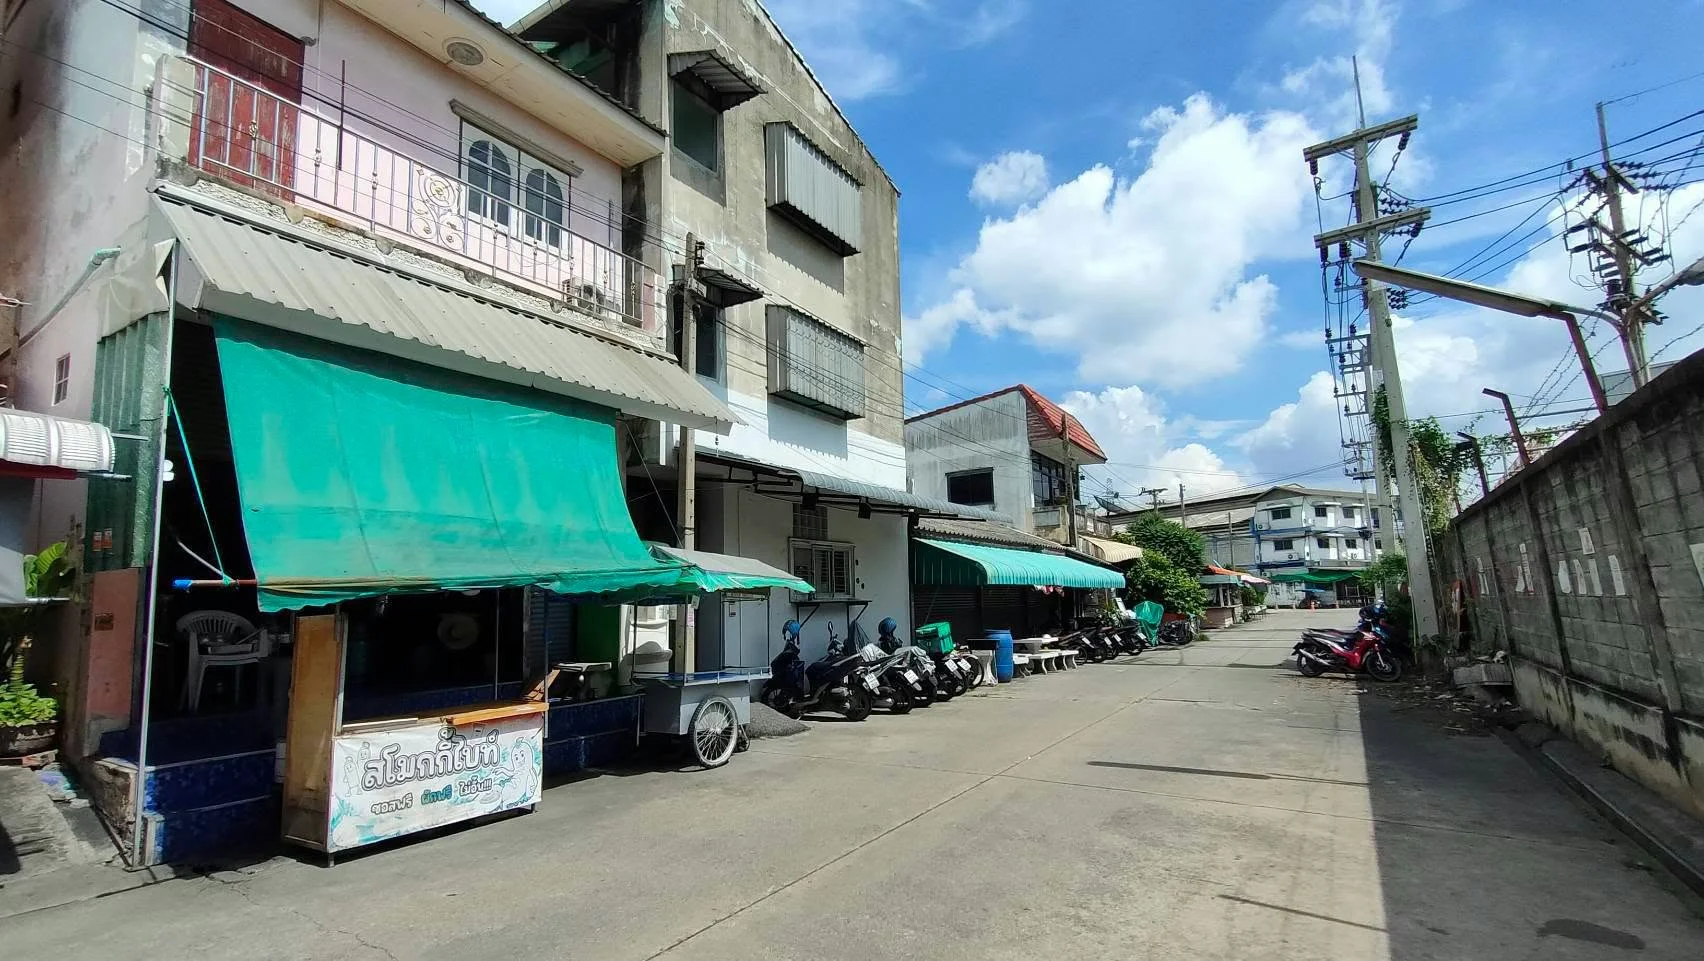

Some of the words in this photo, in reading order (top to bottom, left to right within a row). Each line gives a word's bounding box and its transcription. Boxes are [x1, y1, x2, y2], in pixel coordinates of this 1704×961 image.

[361, 726, 500, 791] สโมกกี้ไบท์
[371, 792, 413, 815] ซอสฟรี
[421, 784, 453, 805] ผักฟรี
